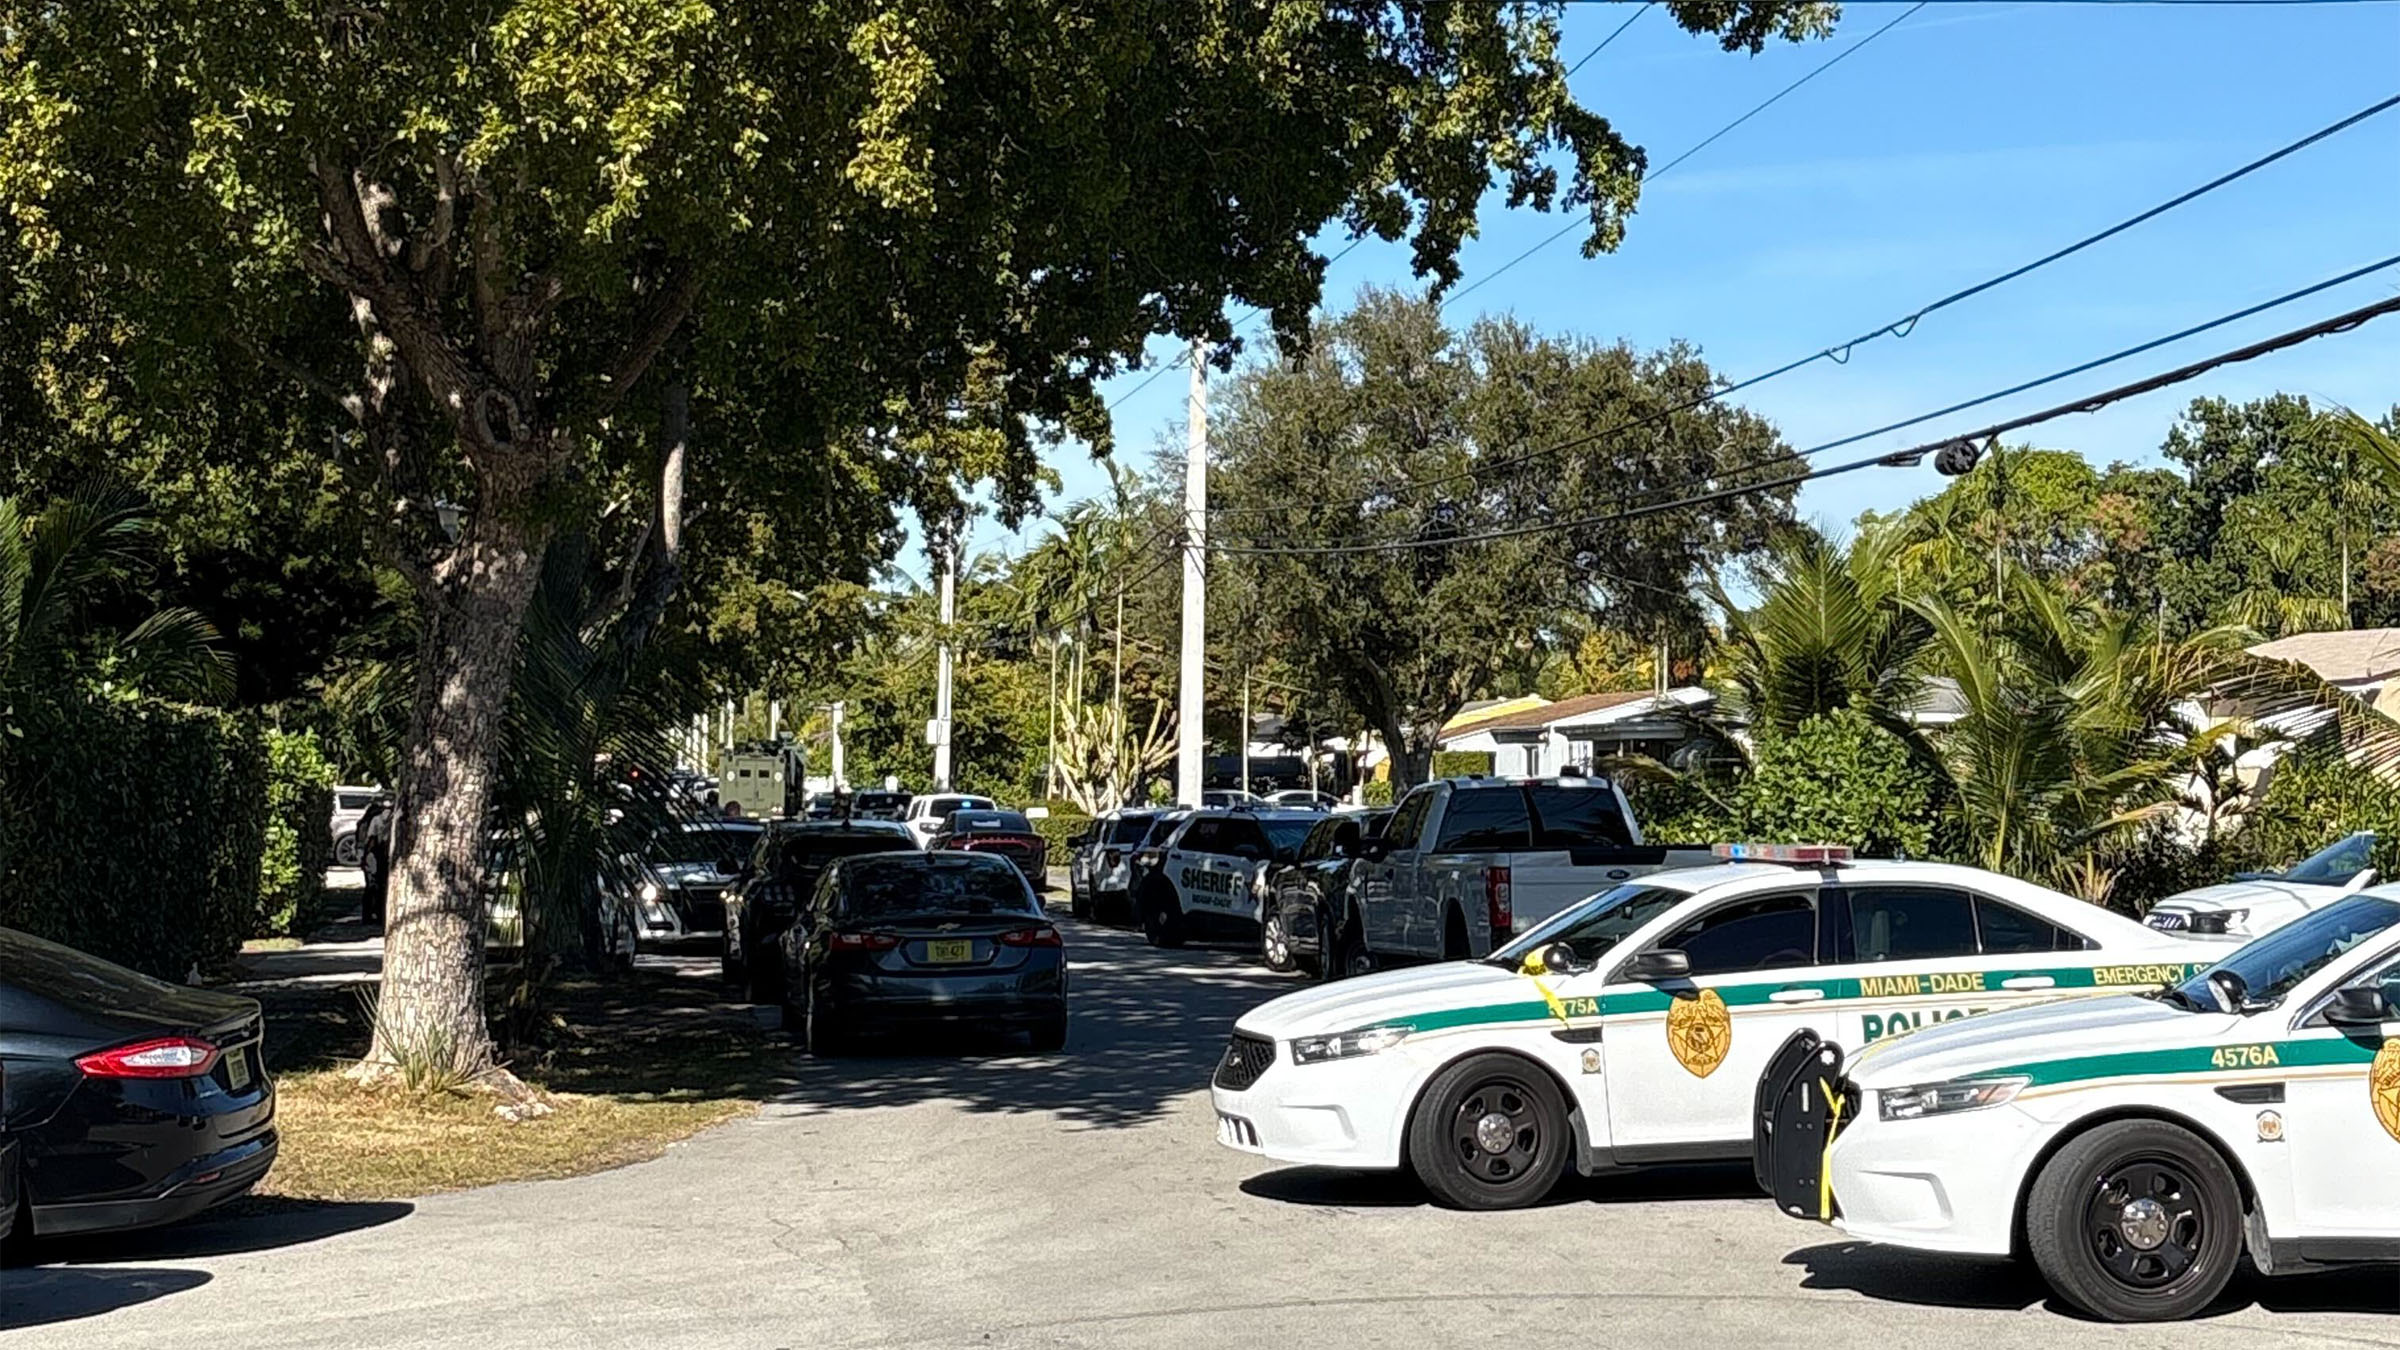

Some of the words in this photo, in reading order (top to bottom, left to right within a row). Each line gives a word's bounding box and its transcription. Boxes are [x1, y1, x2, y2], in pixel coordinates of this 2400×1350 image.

[1181, 867, 1243, 896] SHERIFF
[1860, 973, 1986, 997] MIAMI-DADE
[2093, 965, 2185, 985] EMERGENCY
[1548, 998, 1600, 1016] 75A
[1861, 1008, 1989, 1044] POL
[2211, 1045, 2280, 1068] 4576A
